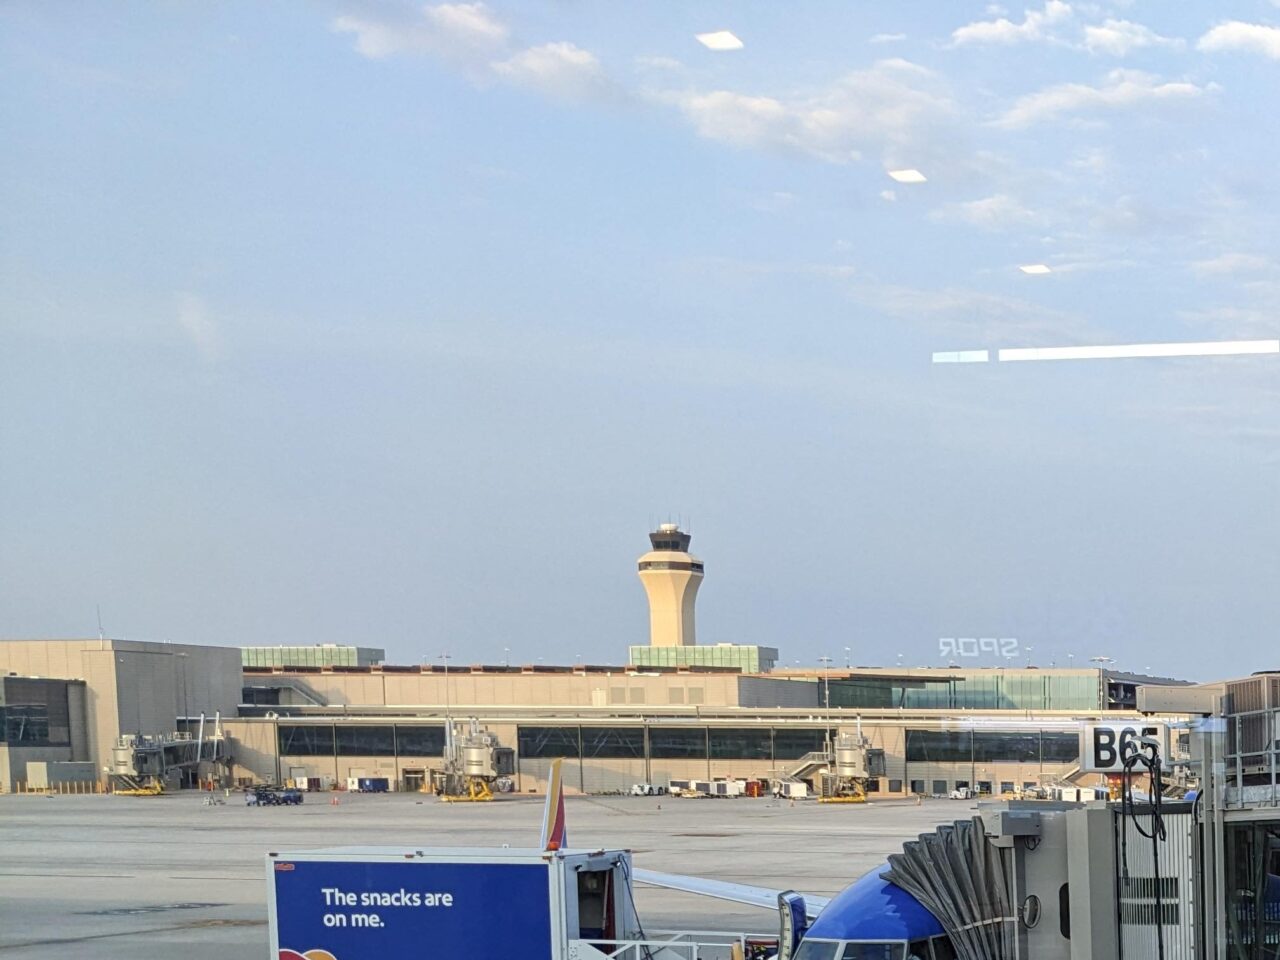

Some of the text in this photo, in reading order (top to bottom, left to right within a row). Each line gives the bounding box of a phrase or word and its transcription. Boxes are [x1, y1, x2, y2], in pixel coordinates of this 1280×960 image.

[1094, 727, 1157, 768] B65
[321, 888, 453, 906] The snacks are
[323, 913, 385, 927] on me.
